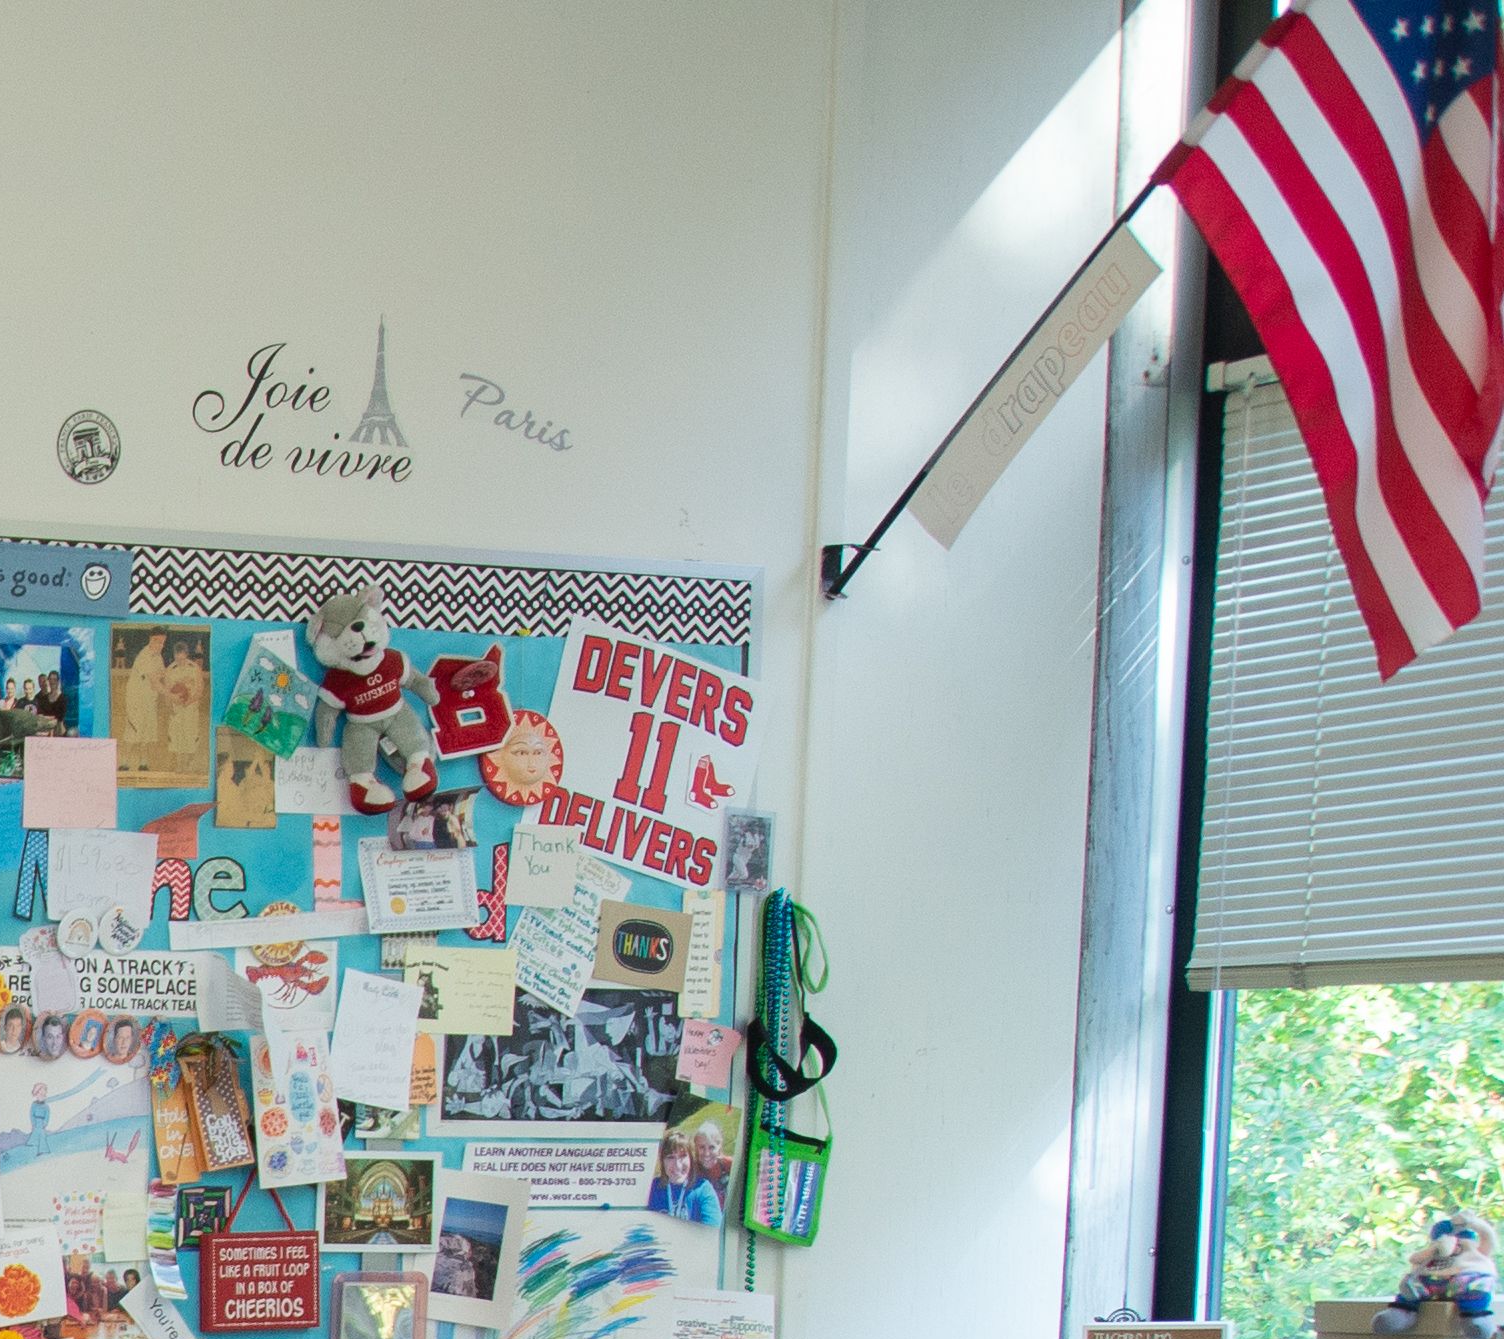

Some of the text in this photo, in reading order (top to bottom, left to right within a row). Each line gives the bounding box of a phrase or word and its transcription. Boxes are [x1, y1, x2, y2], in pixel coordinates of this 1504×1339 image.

[192, 342, 332, 433] Joie
[459, 372, 575, 452] Paris
[219, 413, 413, 483] de vivre
[367, 674, 382, 686] GO
[573, 635, 753, 747] DEVERS
[613, 711, 681, 815] 11
[538, 785, 717, 886] DELIVERS
[618, 931, 669, 961] THANKS
[474, 1147, 648, 1158] LEARN ANOTHER LANGUAGE BECAUSE
[473, 1163, 645, 1172] REAL LIFE DOES NOT HAVE SUBTITLES
[219, 1246, 310, 1261] SOMETIMES I FEEL
[220, 1263, 310, 1278] LIKE A FRUIT LOOP
[236, 1281, 294, 1295] IN A BOX OF
[225, 1297, 304, 1319] CHEERIOS
